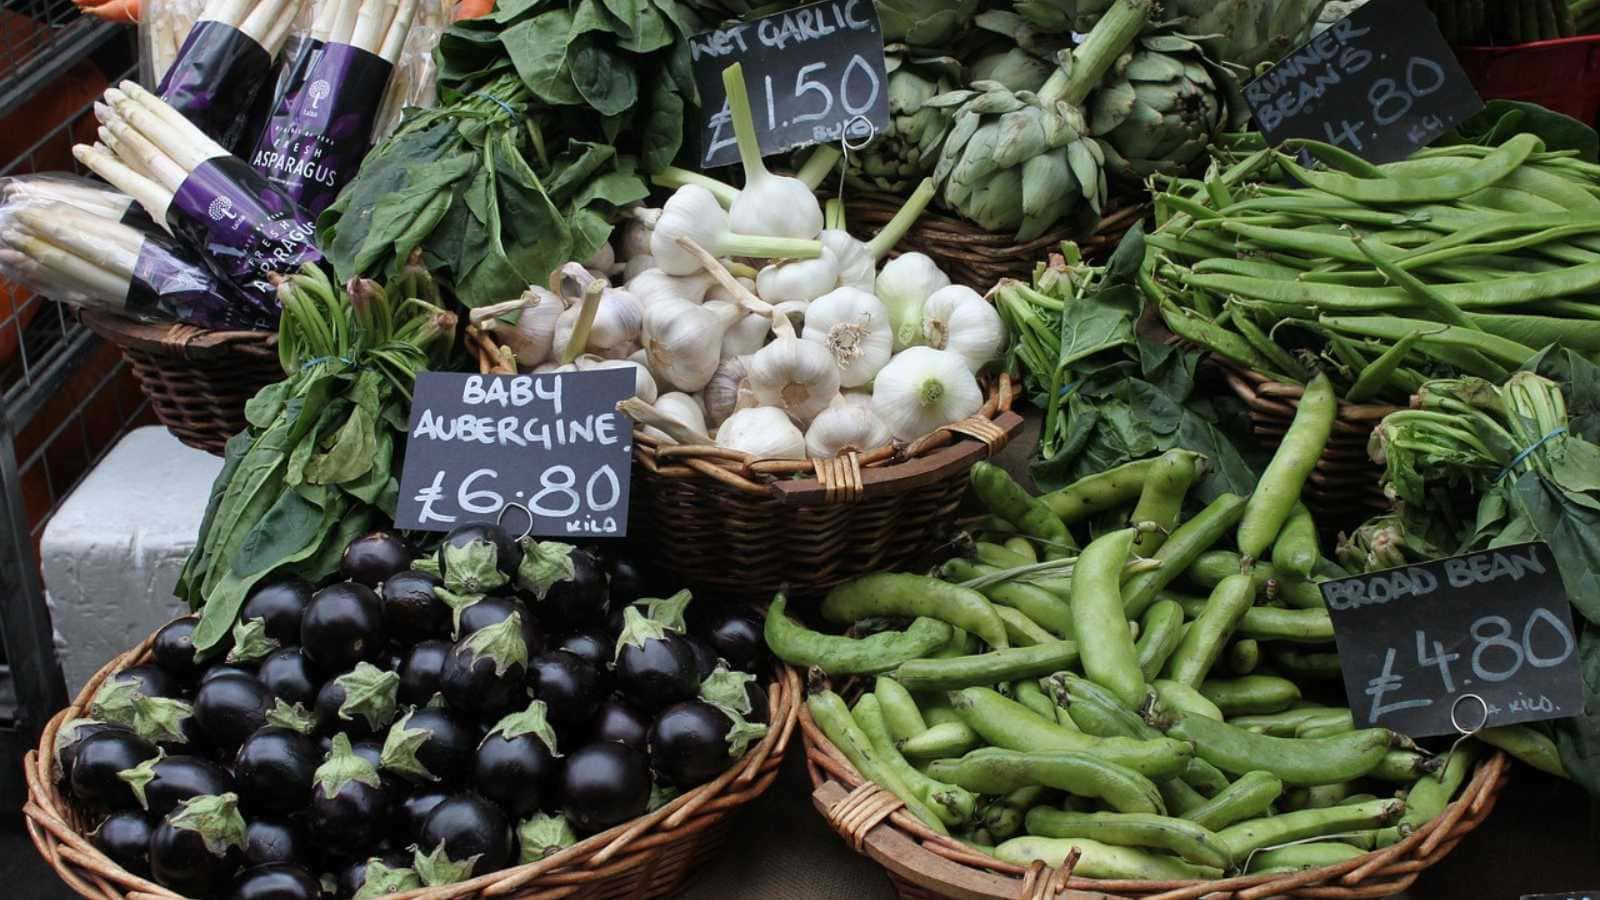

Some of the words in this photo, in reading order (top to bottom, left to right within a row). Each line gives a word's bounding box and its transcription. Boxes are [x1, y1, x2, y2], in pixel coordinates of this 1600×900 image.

[690, 26, 750, 62] WET
[1246, 17, 1371, 107] RUNNER
[252, 150, 337, 187] ASPARAGUS
[247, 219, 292, 268] FRESH
[252, 220, 317, 294] APARAGU
[462, 374, 563, 415] BABY
[413, 463, 621, 524] £6.80
[1323, 567, 1439, 611] BROAD
[1443, 545, 1547, 588] BEAN
[1364, 607, 1576, 724] £4.80
